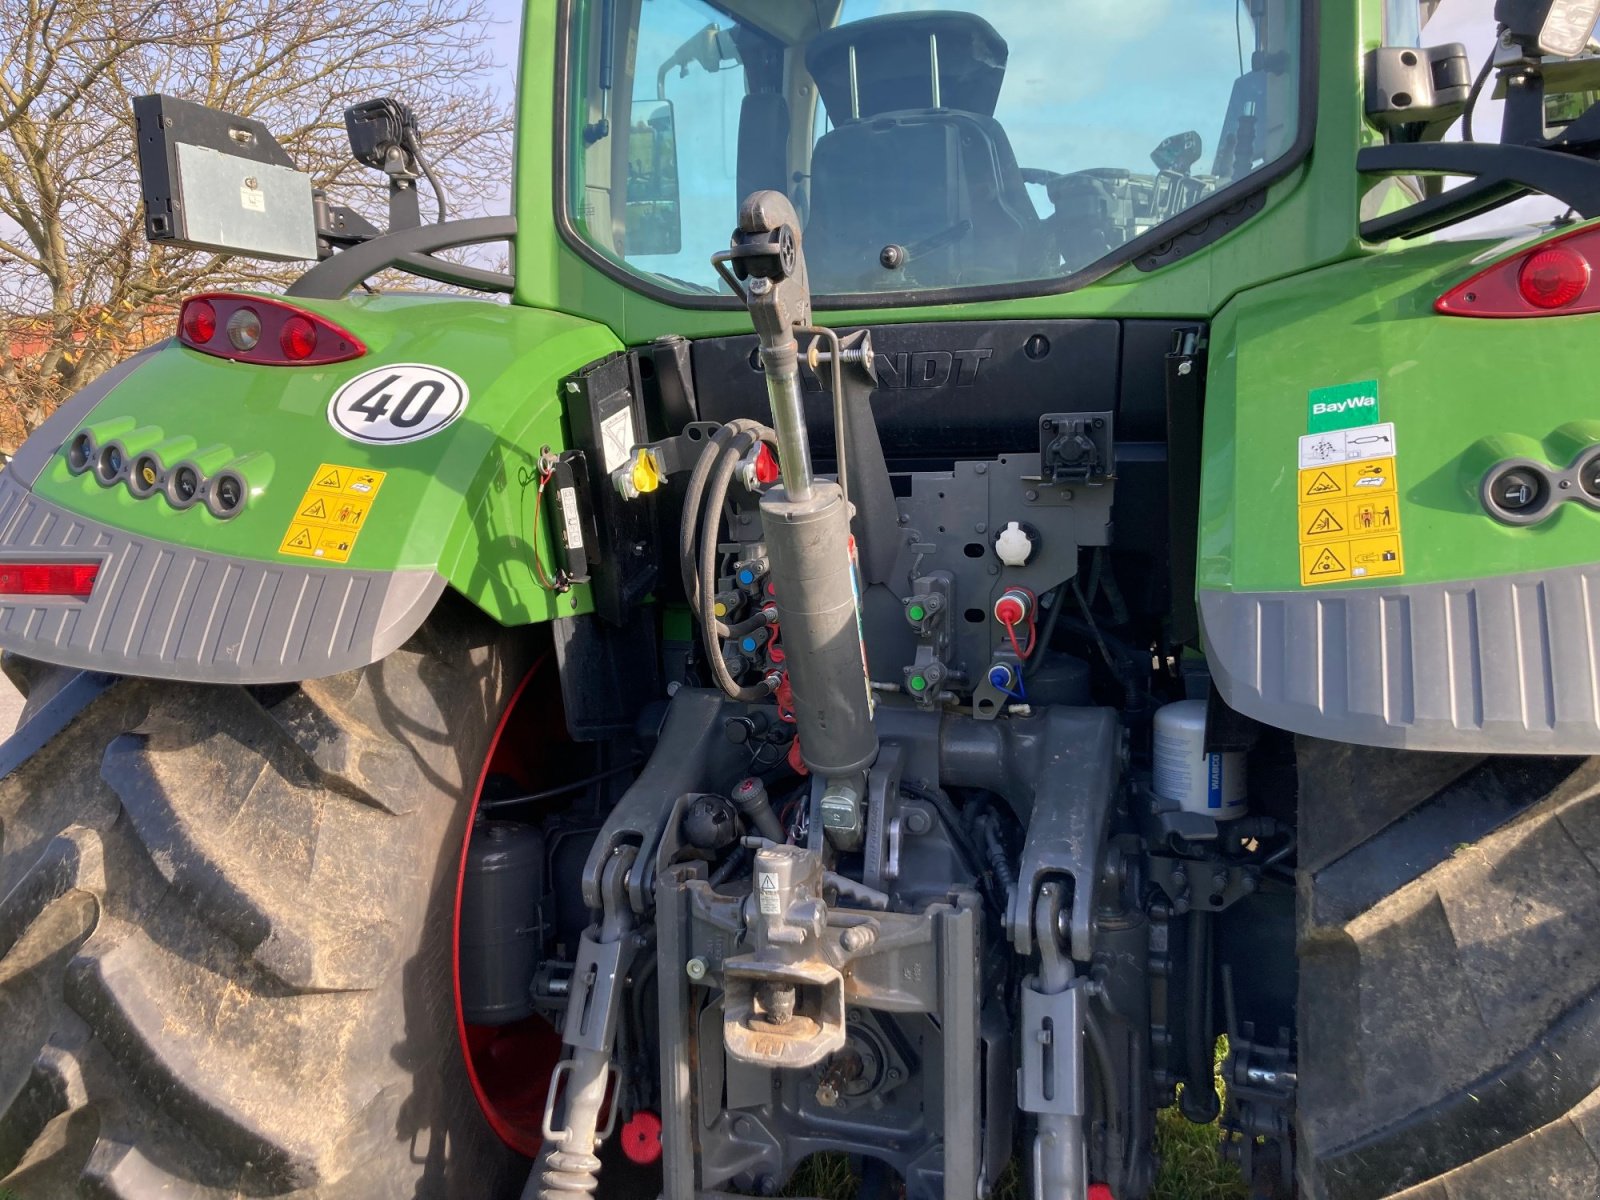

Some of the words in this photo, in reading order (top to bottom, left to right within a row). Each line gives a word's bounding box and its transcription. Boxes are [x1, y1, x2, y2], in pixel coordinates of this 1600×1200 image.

[803, 349, 993, 392] NDT
[347, 374, 446, 428] 40
[1312, 396, 1376, 415] BayWa
